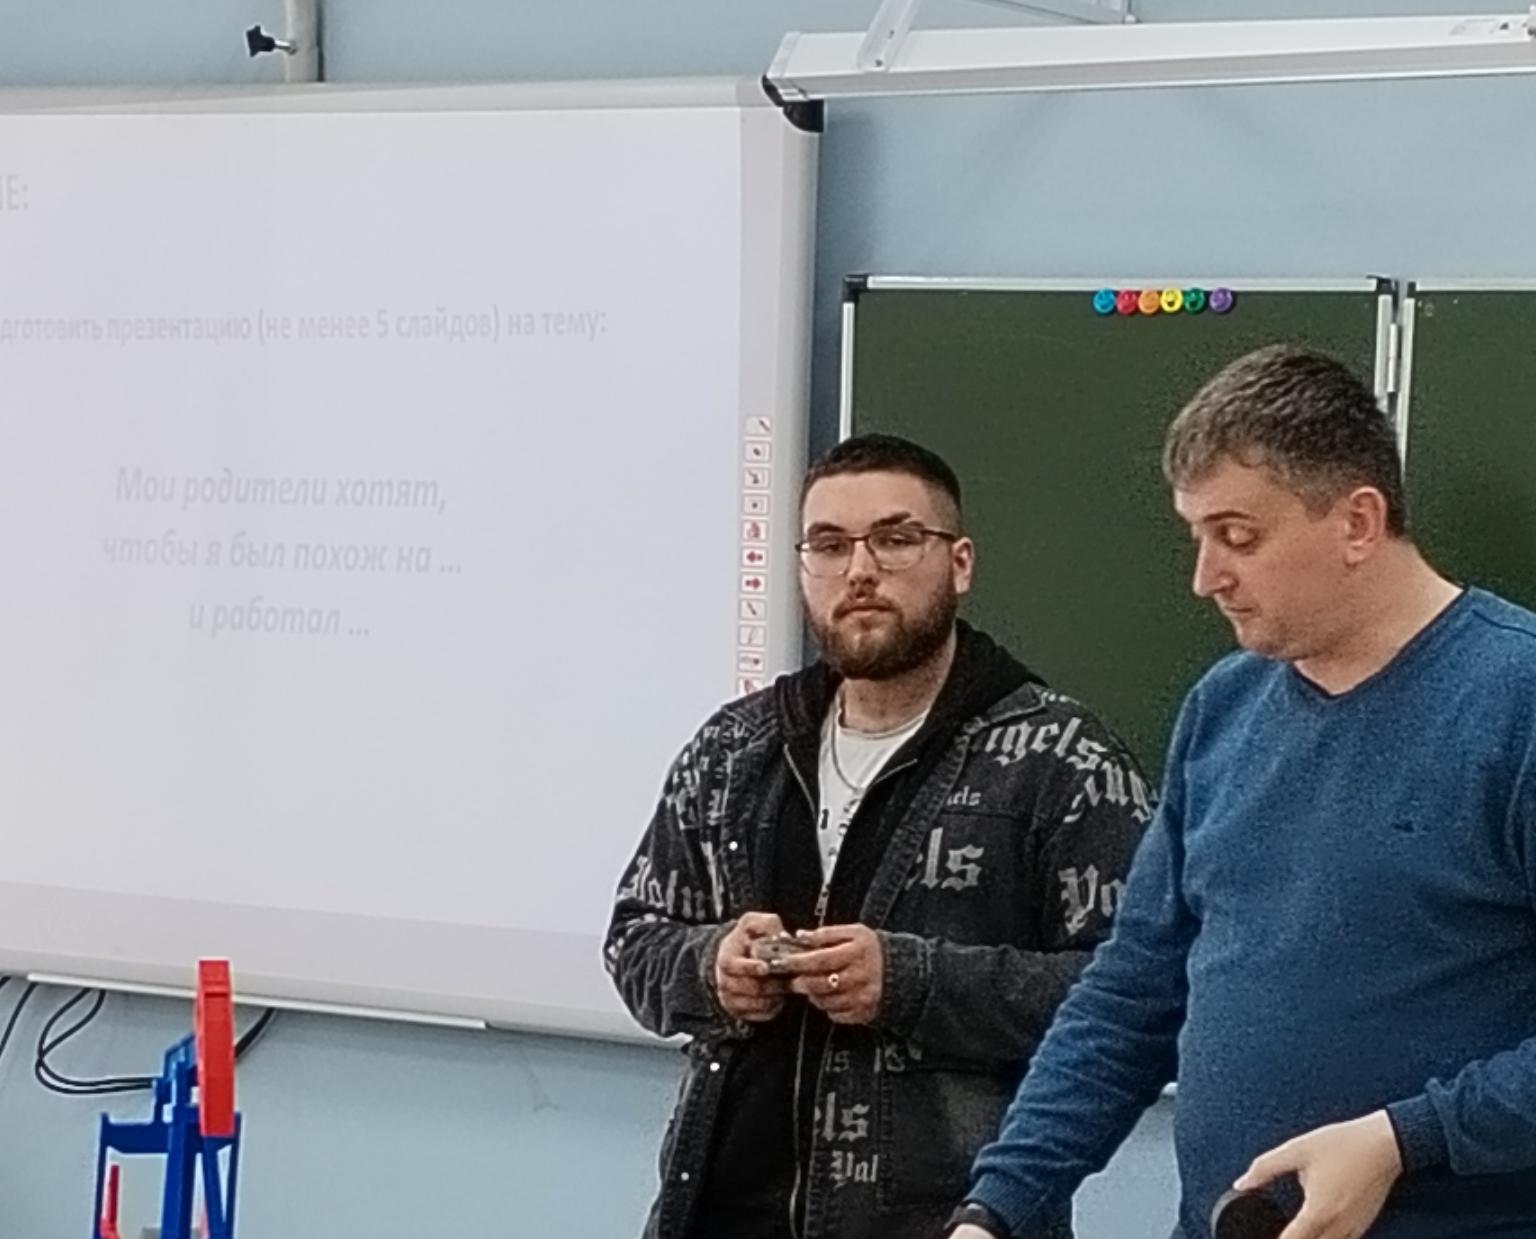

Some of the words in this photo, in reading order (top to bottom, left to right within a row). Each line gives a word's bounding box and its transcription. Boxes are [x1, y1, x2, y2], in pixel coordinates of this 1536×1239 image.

[106, 316, 252, 347] презентацию
[257, 307, 292, 346] (не
[298, 313, 370, 340] менее
[376, 308, 389, 339] 5
[395, 303, 501, 344] слайдов)
[507, 311, 536, 336] на
[541, 309, 608, 342] тему:
[115, 465, 176, 503] Мои
[181, 465, 328, 511] родители
[334, 476, 448, 515] хотят,
[102, 528, 200, 567] чтобы
[204, 540, 222, 567] я
[230, 530, 286, 569] был
[293, 541, 388, 573] похож
[395, 544, 432, 574] на
[188, 602, 205, 630] и
[212, 595, 341, 639] работал
